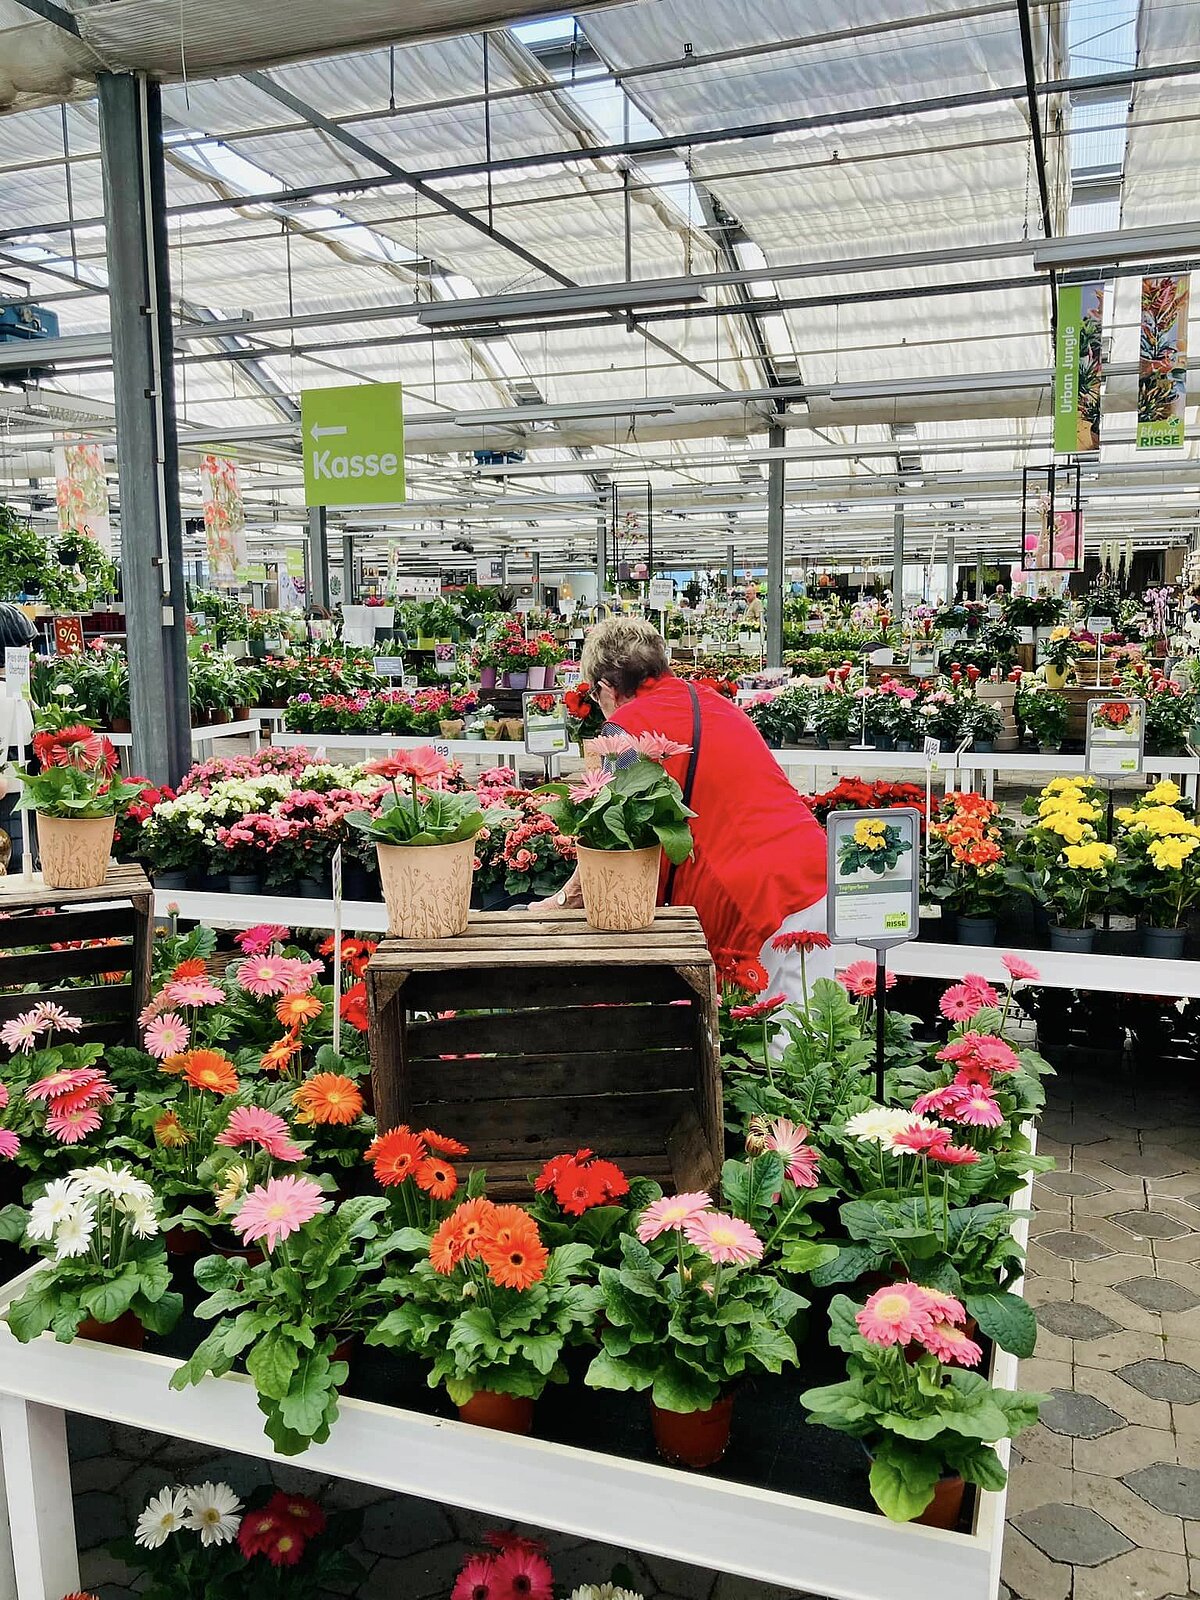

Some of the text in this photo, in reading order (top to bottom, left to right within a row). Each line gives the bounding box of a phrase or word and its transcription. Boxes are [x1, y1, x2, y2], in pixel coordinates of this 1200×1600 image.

[1060, 326, 1077, 414] Urban Jungle
[1140, 435, 1180, 447] RISSE
[312, 449, 398, 481] Kasse
[59, 627, 78, 644] %
[886, 920, 906, 928] RISSE
